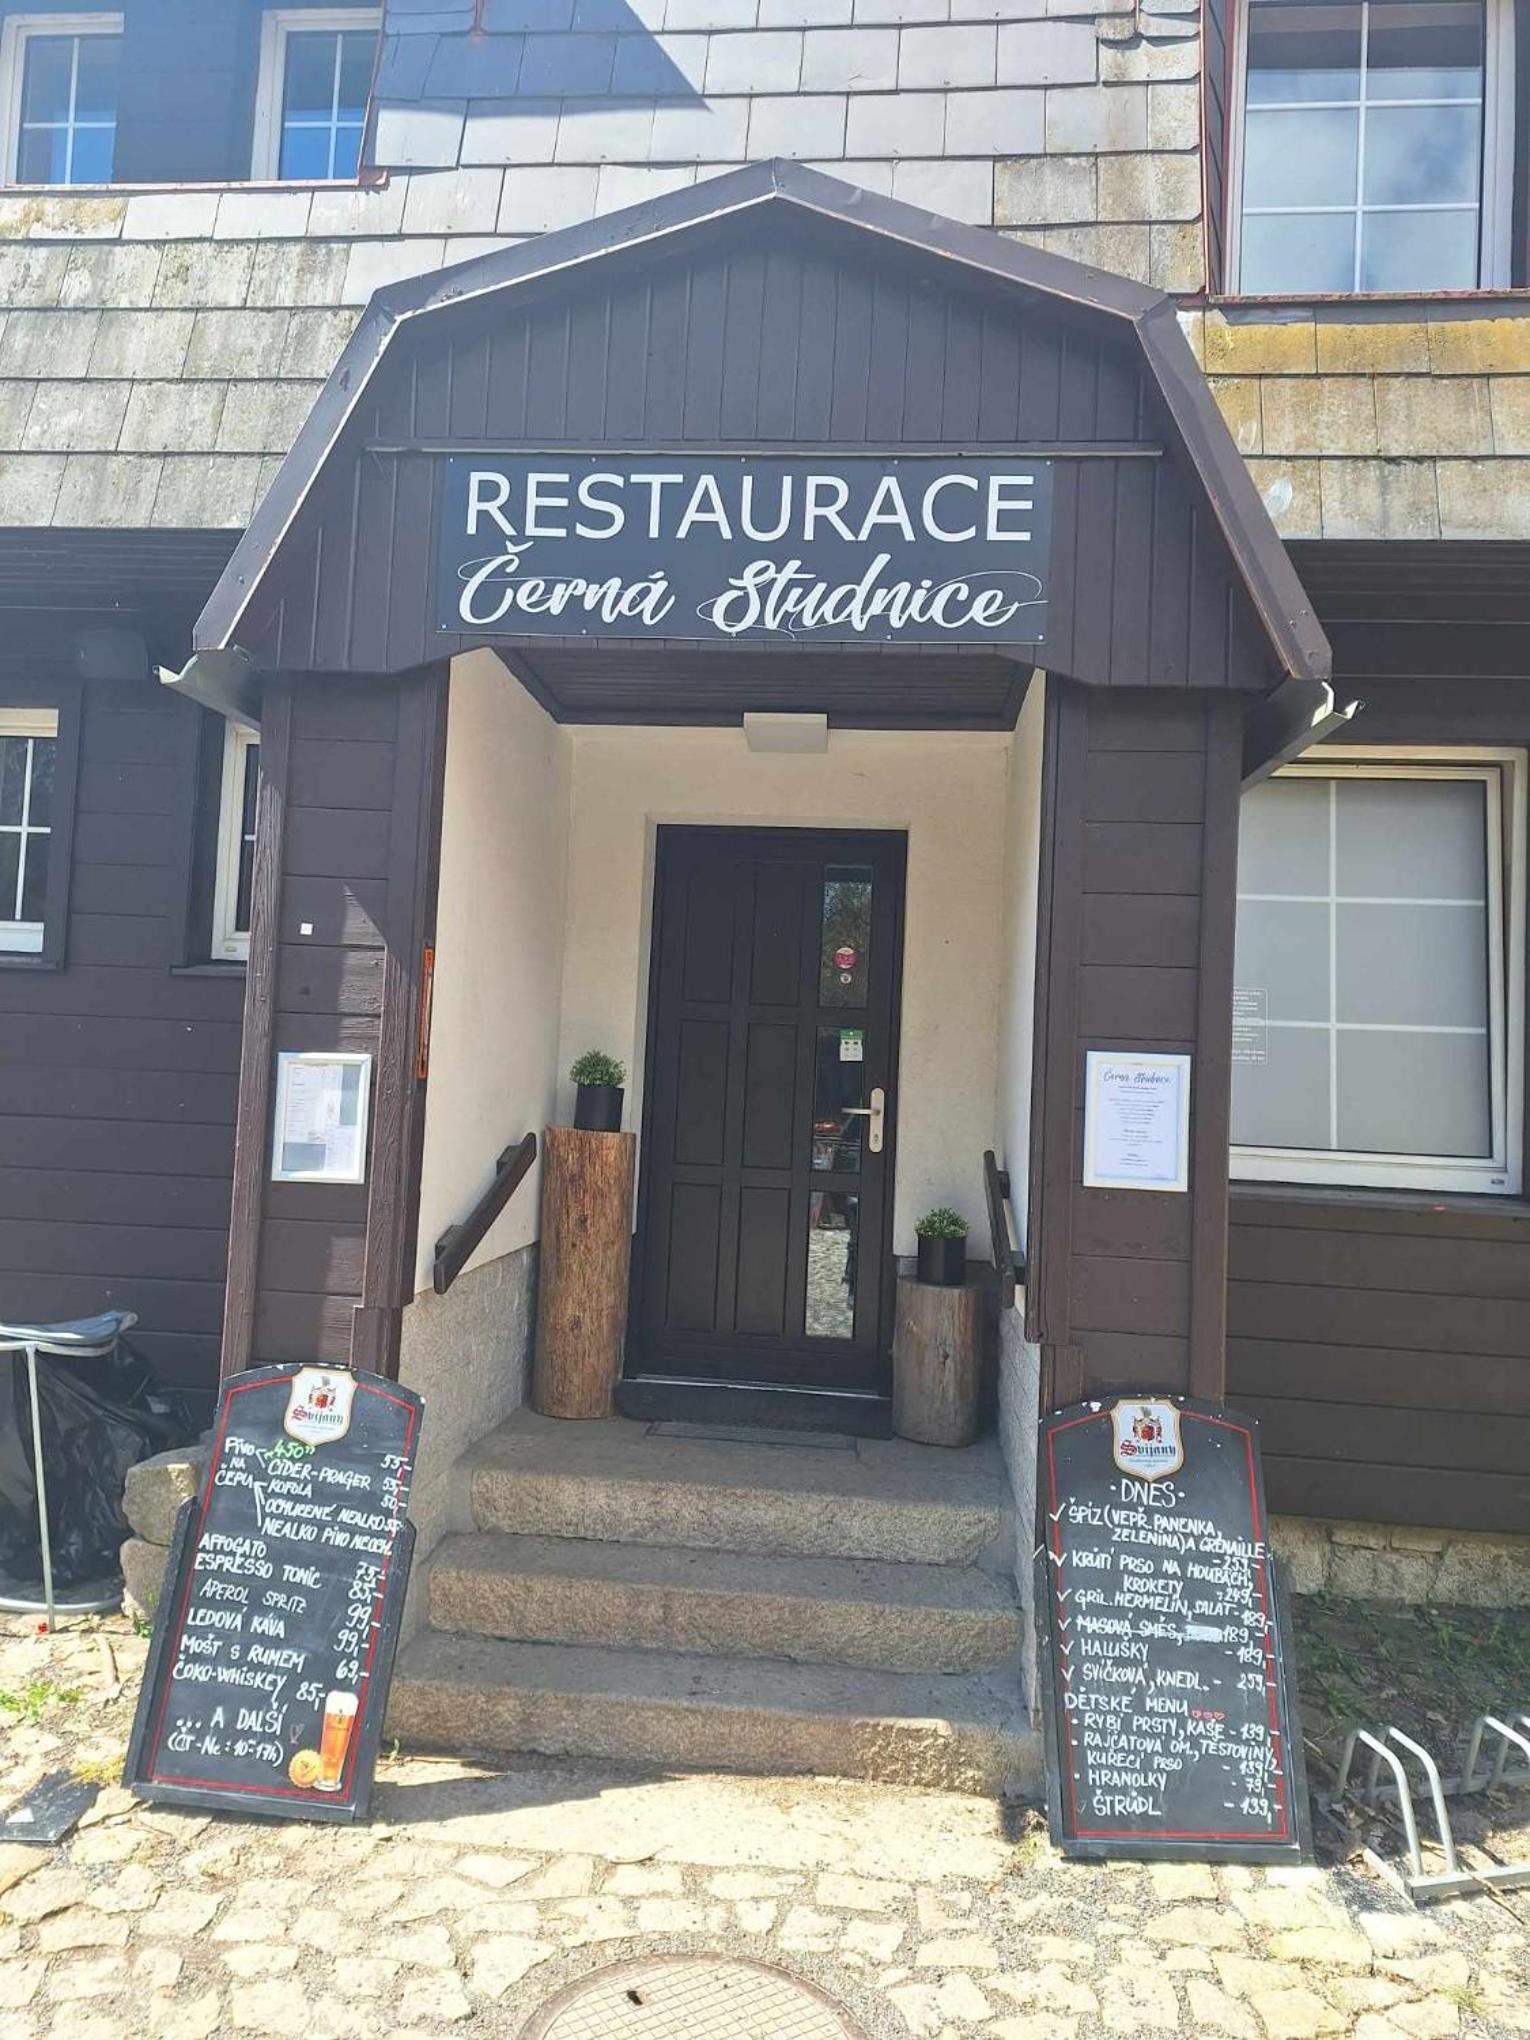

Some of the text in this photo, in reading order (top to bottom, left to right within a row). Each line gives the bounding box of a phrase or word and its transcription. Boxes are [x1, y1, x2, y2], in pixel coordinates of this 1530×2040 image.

[466, 471, 1035, 542] RESTAURACE
[457, 540, 1048, 640] Černá Studnice
[1119, 1439, 1176, 1457] Svijany
[214, 1462, 253, 1488] ČEPU
[229, 1457, 246, 1469] NA
[267, 1478, 313, 1499] KOFOLA
[1121, 1479, 1176, 1508] DNES
[260, 1517, 318, 1541] NEALKO
[336, 1508, 385, 1531] NEALKO
[1154, 1513, 1222, 1540] PANENKA,
[198, 1533, 267, 1558] AFFOGATO
[1186, 1536, 1196, 1550] A
[194, 1553, 274, 1579] ESPRESSO
[1119, 1553, 1154, 1574] PRSO
[1162, 1559, 1181, 1577] NA
[199, 1578, 249, 1604] APEROL
[262, 1590, 307, 1613] SPRITZ
[1122, 1574, 1184, 1599] KROKETY
[187, 1606, 248, 1632] LEDOVÁ
[250, 1613, 285, 1639] KÁVA
[1076, 1612, 1133, 1637] MASOVÁ
[179, 1633, 223, 1657] MOŠT
[247, 1644, 307, 1673] RUMEM
[1081, 1636, 1149, 1665] HALUŠKY
[1064, 1686, 1189, 1716] DĚTSKÉ MENU
[210, 1706, 224, 1728] A
[236, 1702, 288, 1736] DALŠÍ
[1186, 1719, 1225, 1739] KAŠE
[1084, 1730, 1165, 1754] RAJČATOVÁ
[1087, 1748, 1144, 1769] KUŘECÍ
[1153, 1756, 1183, 1771] PRSO
[1088, 1770, 1167, 1791] HRANOLKY
